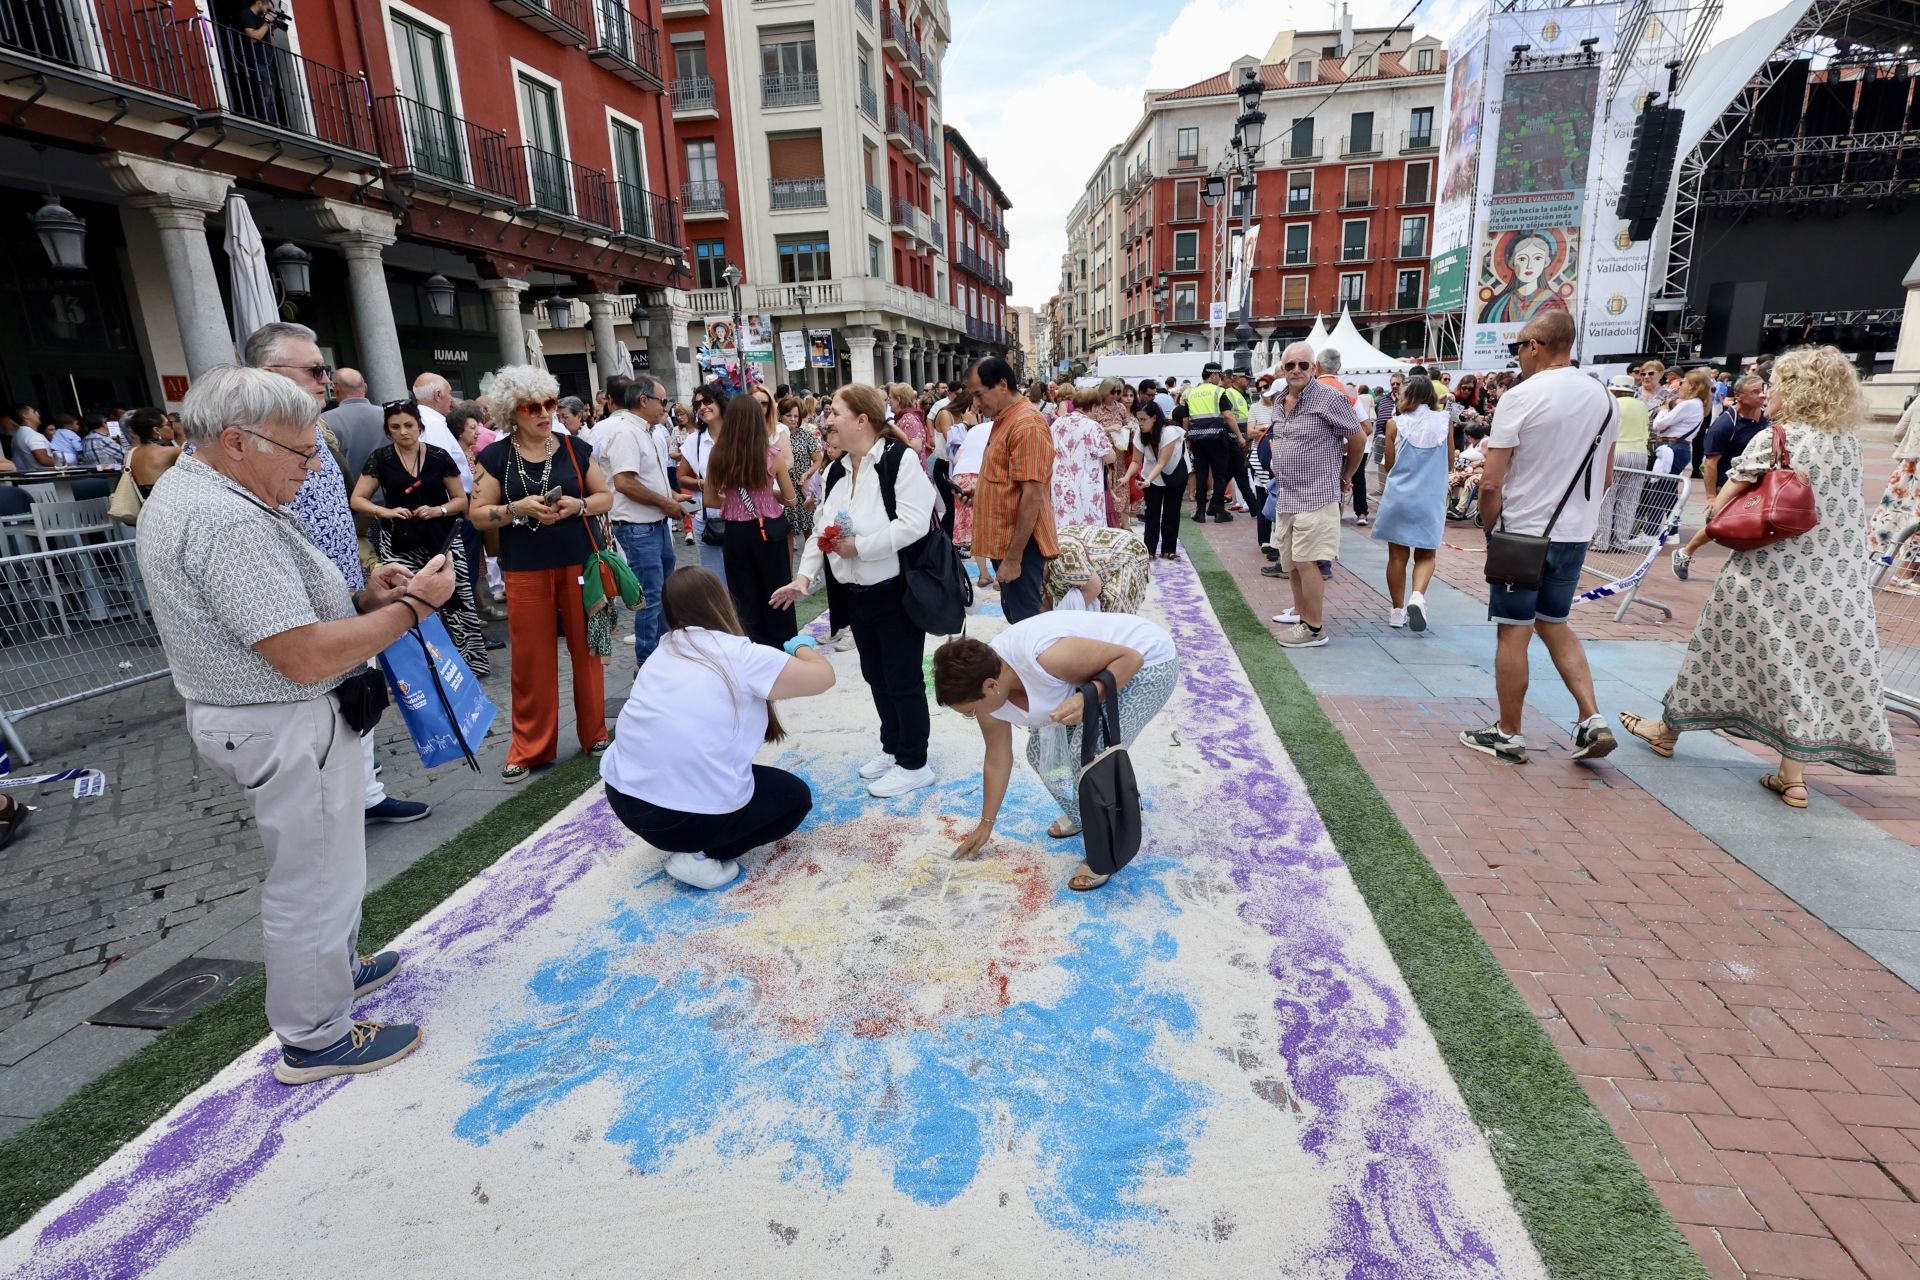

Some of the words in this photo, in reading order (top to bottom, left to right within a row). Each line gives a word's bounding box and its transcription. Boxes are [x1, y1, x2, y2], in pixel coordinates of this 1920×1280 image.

[1498, 196, 1517, 204] CASO
[1540, 205, 1548, 213] la
[1549, 204, 1572, 212] salida
[1501, 215, 1510, 223] de
[1511, 213, 1554, 221] evacuación
[50, 294, 86, 325] 13
[1588, 326, 1639, 337] Valladolid
[1475, 331, 1497, 345] 25
